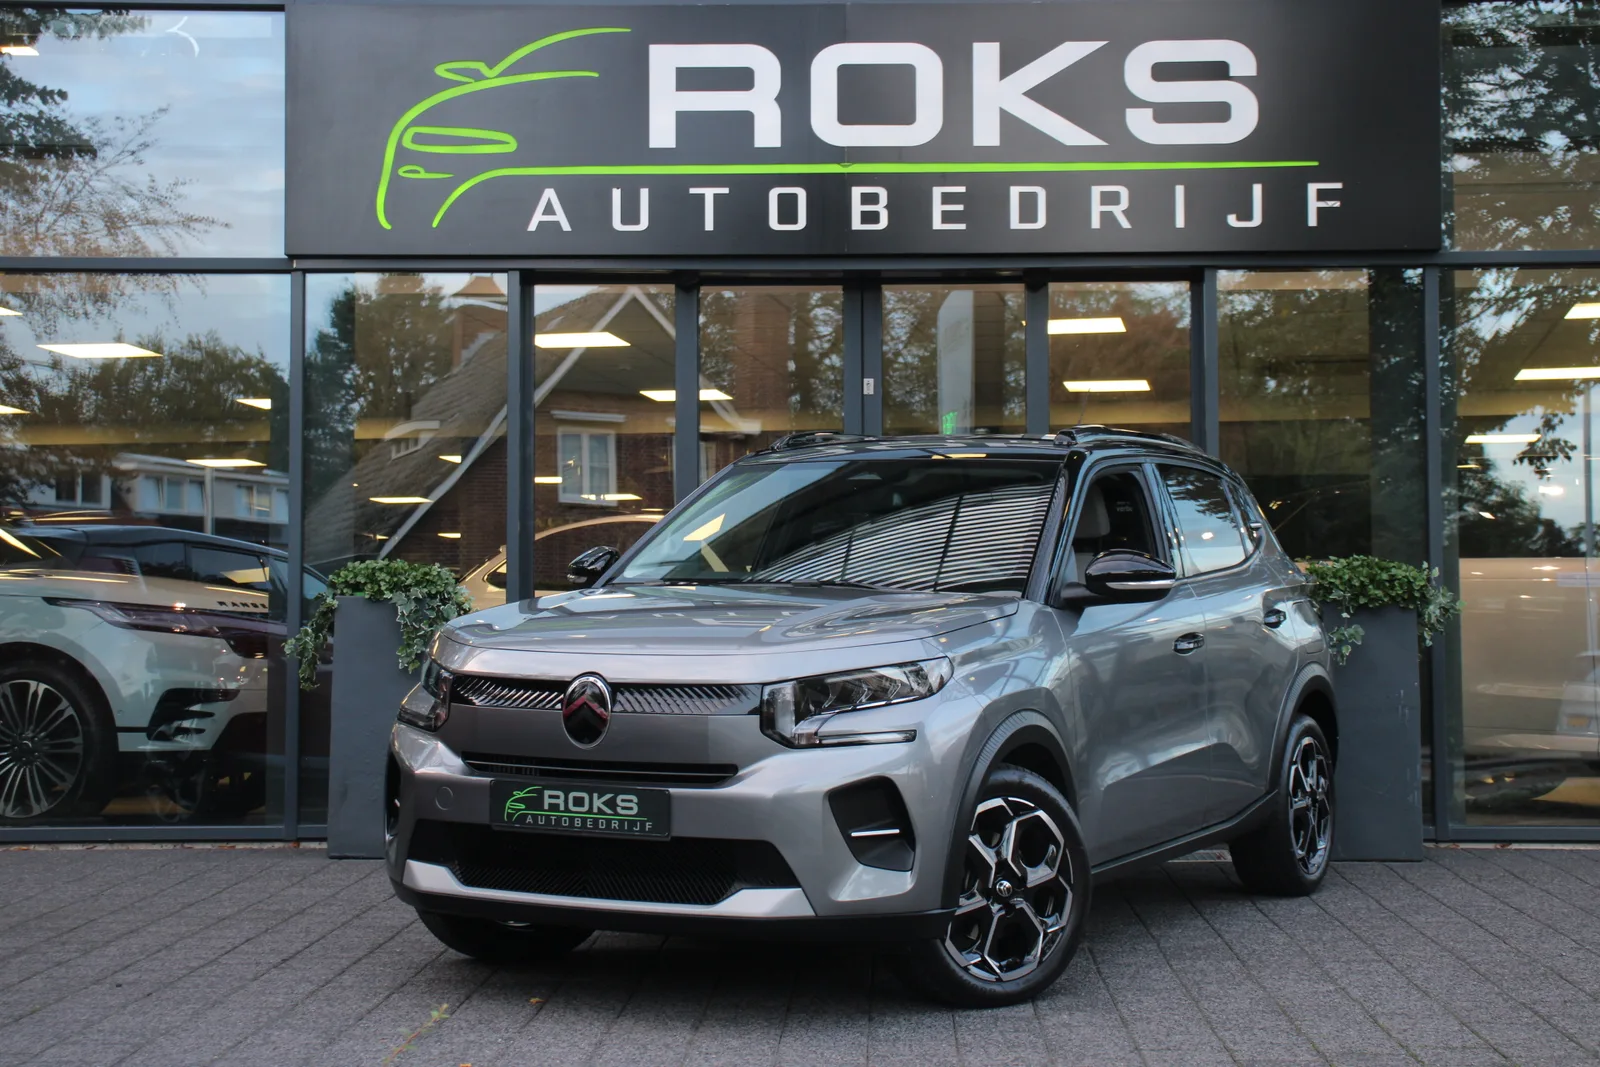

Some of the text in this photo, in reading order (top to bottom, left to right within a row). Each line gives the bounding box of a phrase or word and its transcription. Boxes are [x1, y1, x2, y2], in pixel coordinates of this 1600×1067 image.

[649, 40, 1258, 149] ROKS
[527, 183, 1343, 232] AUTOBEDRIJF
[543, 789, 639, 815] ROKS
[526, 815, 653, 831] AUTOBEDRIJF
